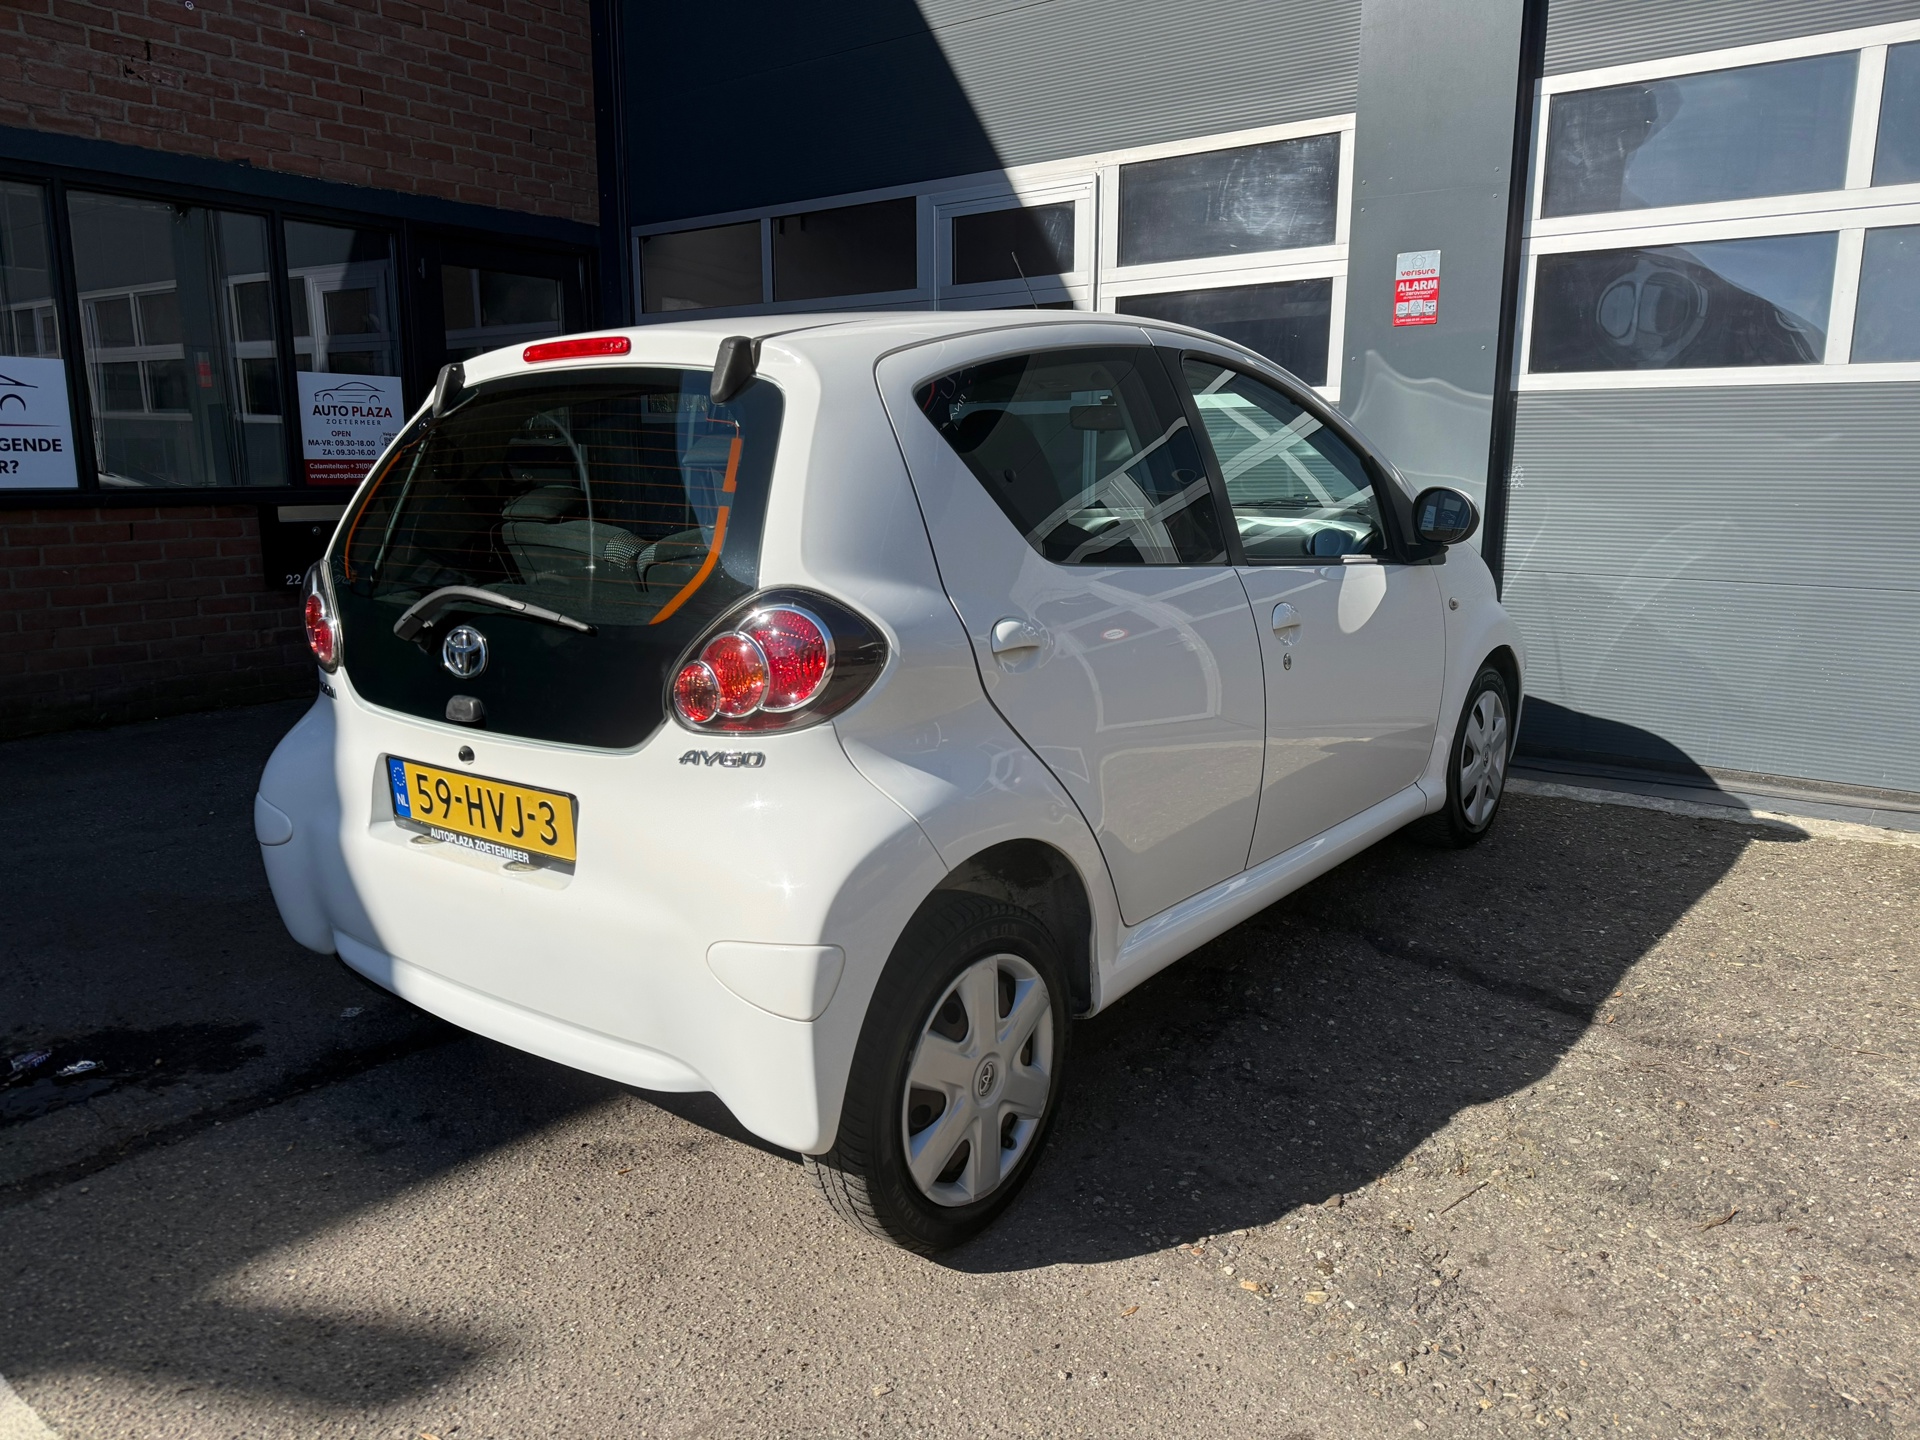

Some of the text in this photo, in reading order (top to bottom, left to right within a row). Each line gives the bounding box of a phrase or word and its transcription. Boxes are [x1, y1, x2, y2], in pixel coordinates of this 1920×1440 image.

[1401, 268, 1436, 277] verisure
[1397, 280, 1438, 292] ALARM
[313, 405, 392, 417] AUTO PLAZA
[326, 418, 382, 426] ZOETERMEER
[308, 439, 334, 447] MA-VR:
[285, 574, 302, 585] 22
[678, 749, 767, 768] AYGO
[396, 792, 409, 808] NL
[415, 773, 558, 846] 59-HVJ-3
[430, 827, 530, 864] AUTOPLAZA ZOETERMEER
